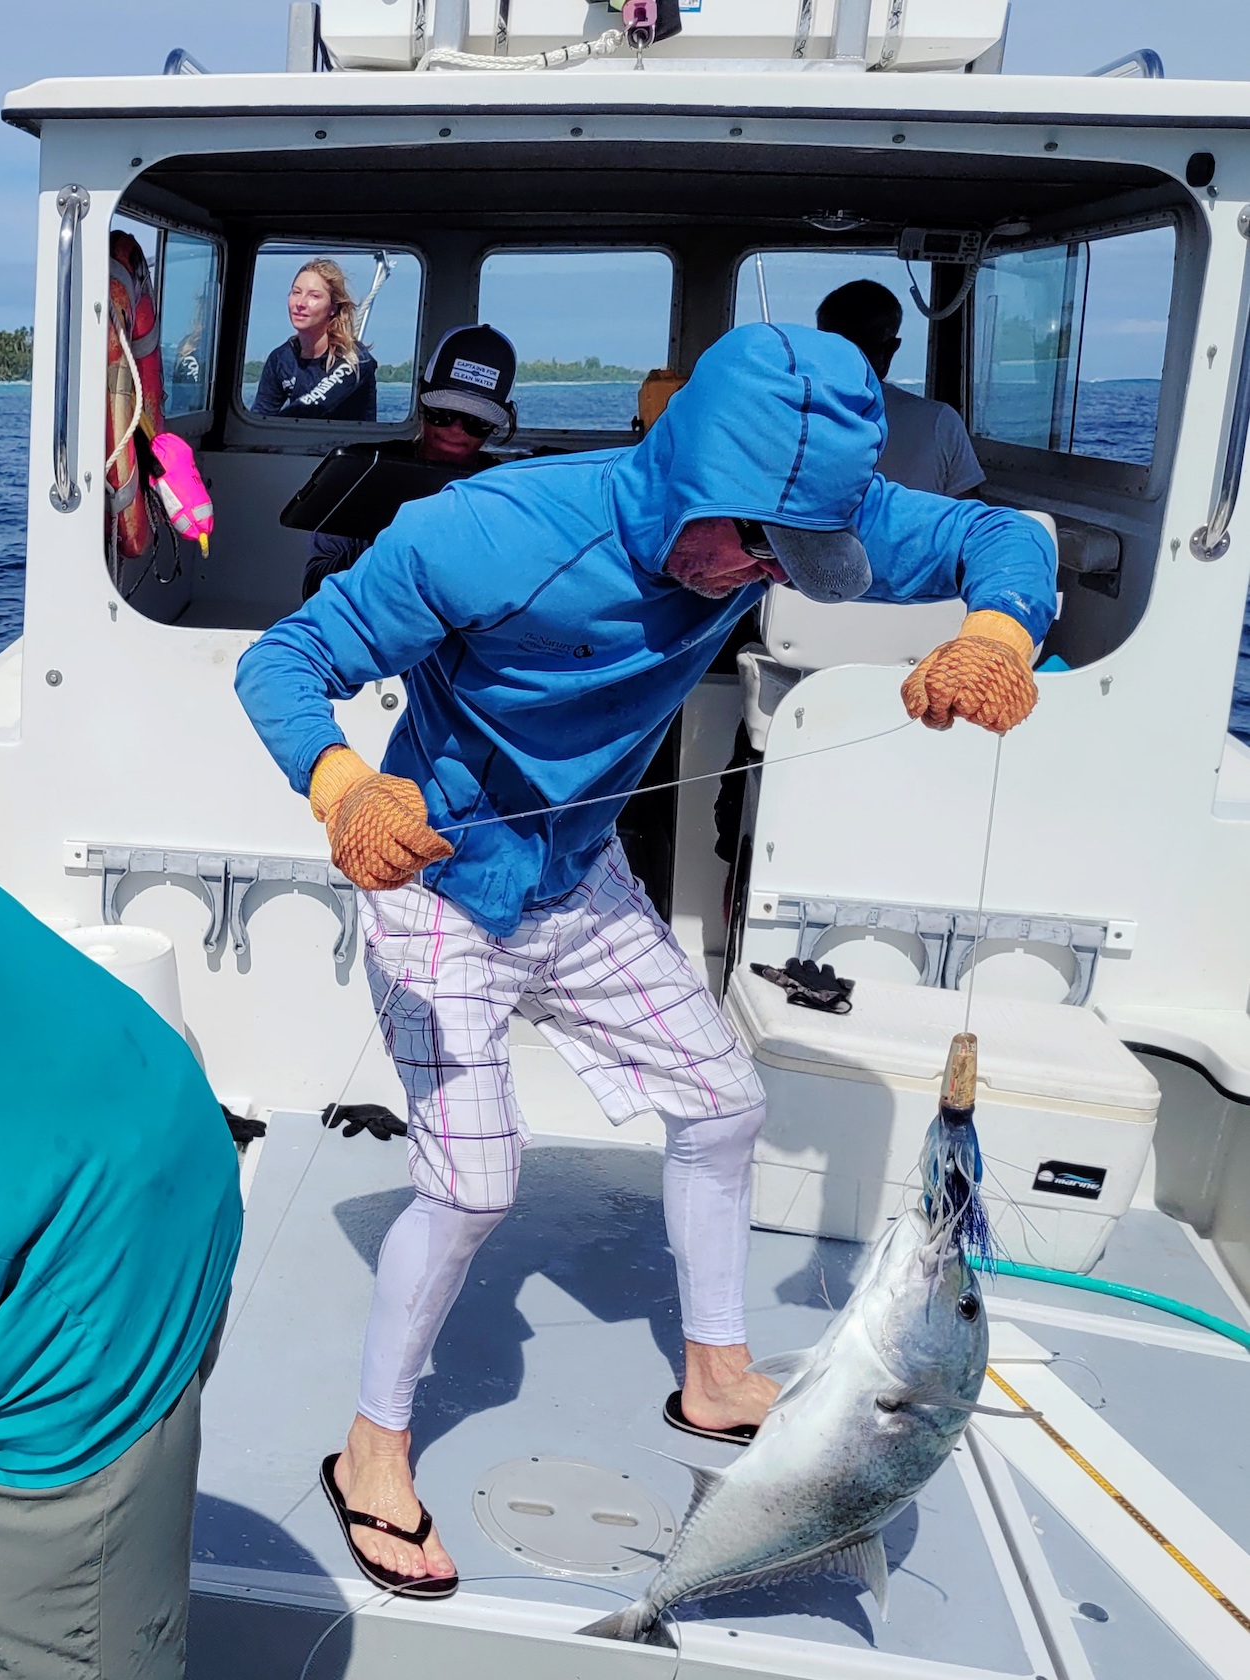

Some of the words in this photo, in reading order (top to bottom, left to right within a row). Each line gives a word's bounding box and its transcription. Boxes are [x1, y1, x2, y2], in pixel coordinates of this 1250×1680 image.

[457, 361, 485, 372] CAPTAINS
[486, 368, 498, 377] FOR
[299, 362, 354, 406] Columbia
[453, 371, 474, 381] CLEAN
[474, 377, 494, 387] WATER
[1053, 1178, 1101, 1190] marine
